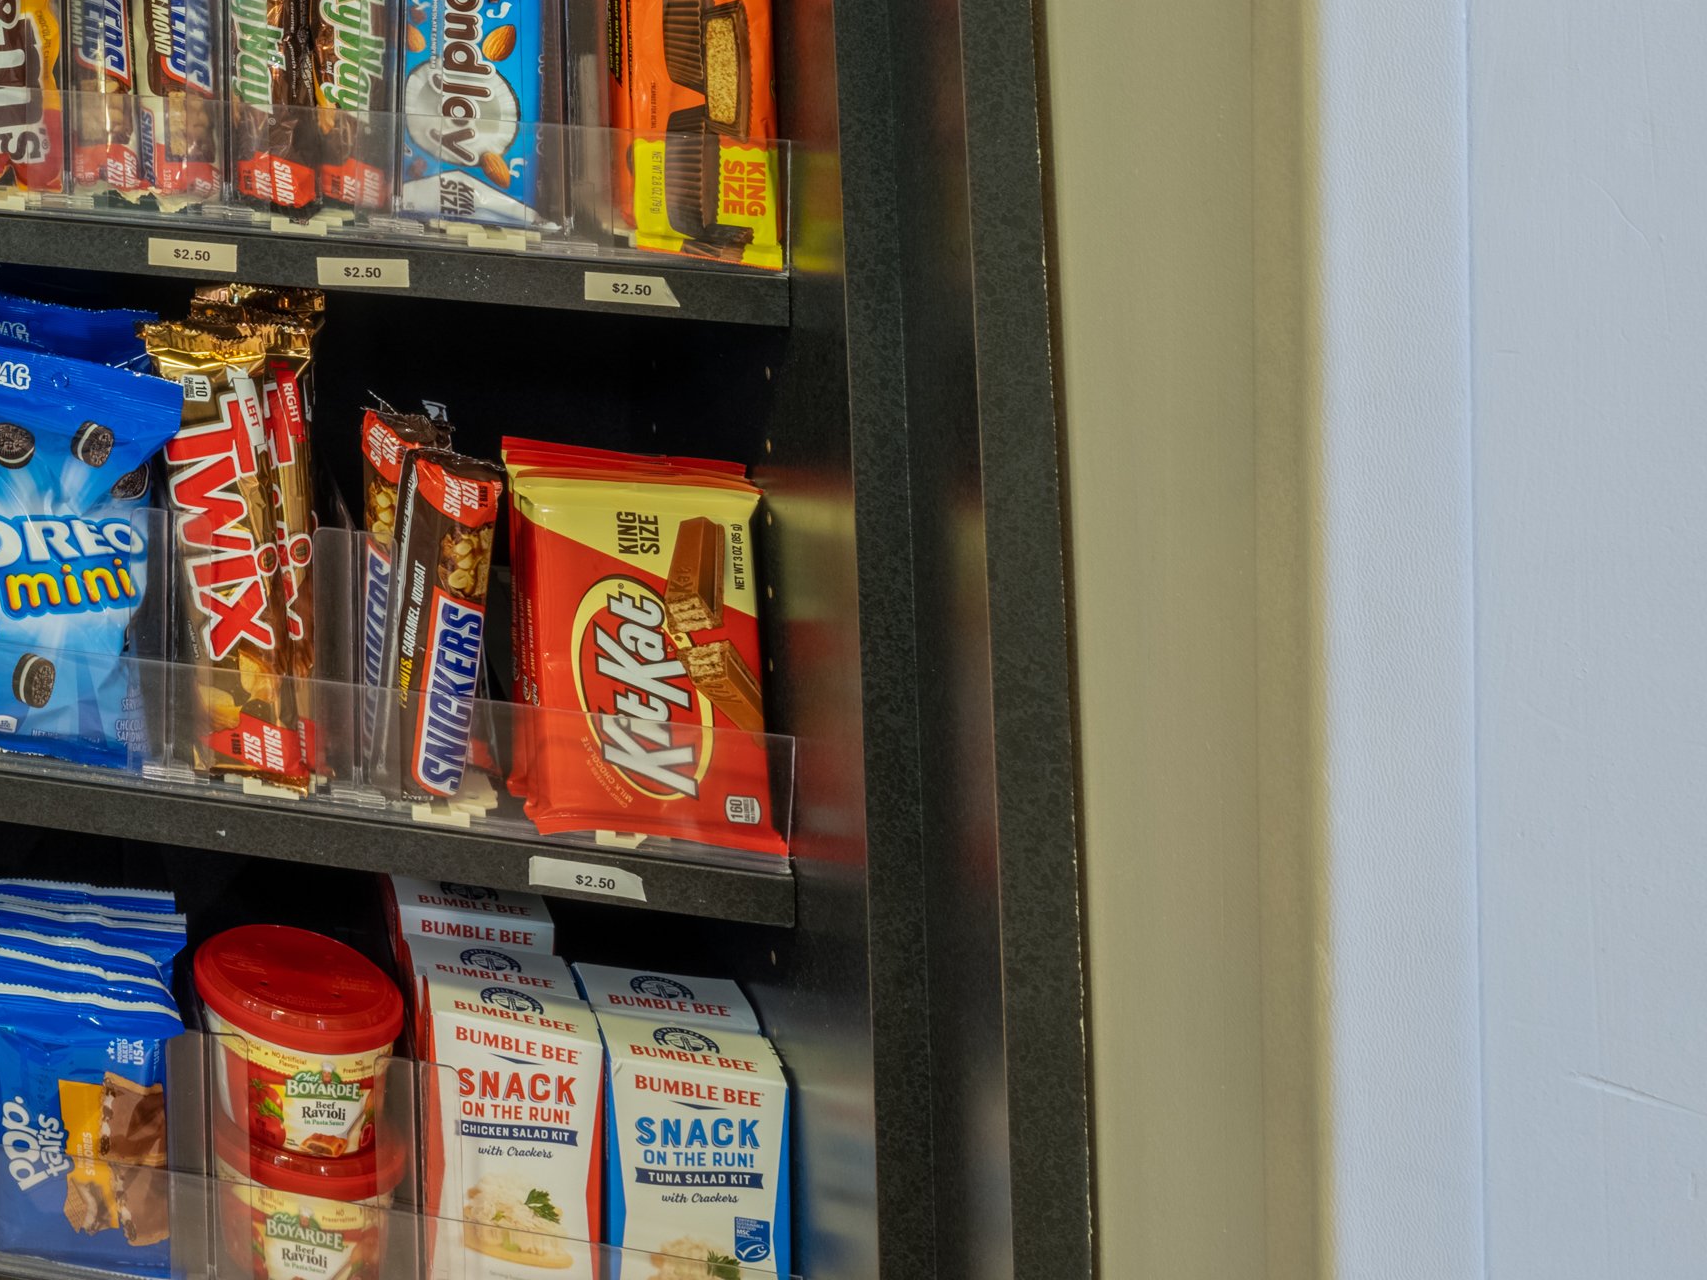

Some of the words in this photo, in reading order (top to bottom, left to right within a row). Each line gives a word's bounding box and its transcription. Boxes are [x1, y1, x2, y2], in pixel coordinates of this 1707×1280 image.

[612, 284, 651, 296] $2.50
[618, 511, 636, 555] KING
[640, 514, 660, 555] SIZE
[8, 559, 135, 609] mini
[418, 603, 484, 793] SNICKERS
[576, 875, 615, 890] $2.50
[294, 1072, 319, 1084] Chef
[287, 1079, 361, 1100] BOYARDEE
[635, 1074, 719, 1100] BUMBLE
[723, 1089, 761, 1107] BEE
[302, 1107, 346, 1122] Ravioli
[315, 1101, 335, 1110] Beef
[636, 1117, 760, 1147] SNACK
[644, 1149, 669, 1164] ON
[674, 1152, 707, 1166] THE
[712, 1152, 754, 1167] RUN!
[649, 1172, 681, 1183] TUNA
[685, 1173, 726, 1183] SALAD
[730, 1174, 750, 1184] KIT
[662, 1191, 687, 1203] with
[692, 1192, 738, 1204] Crackers
